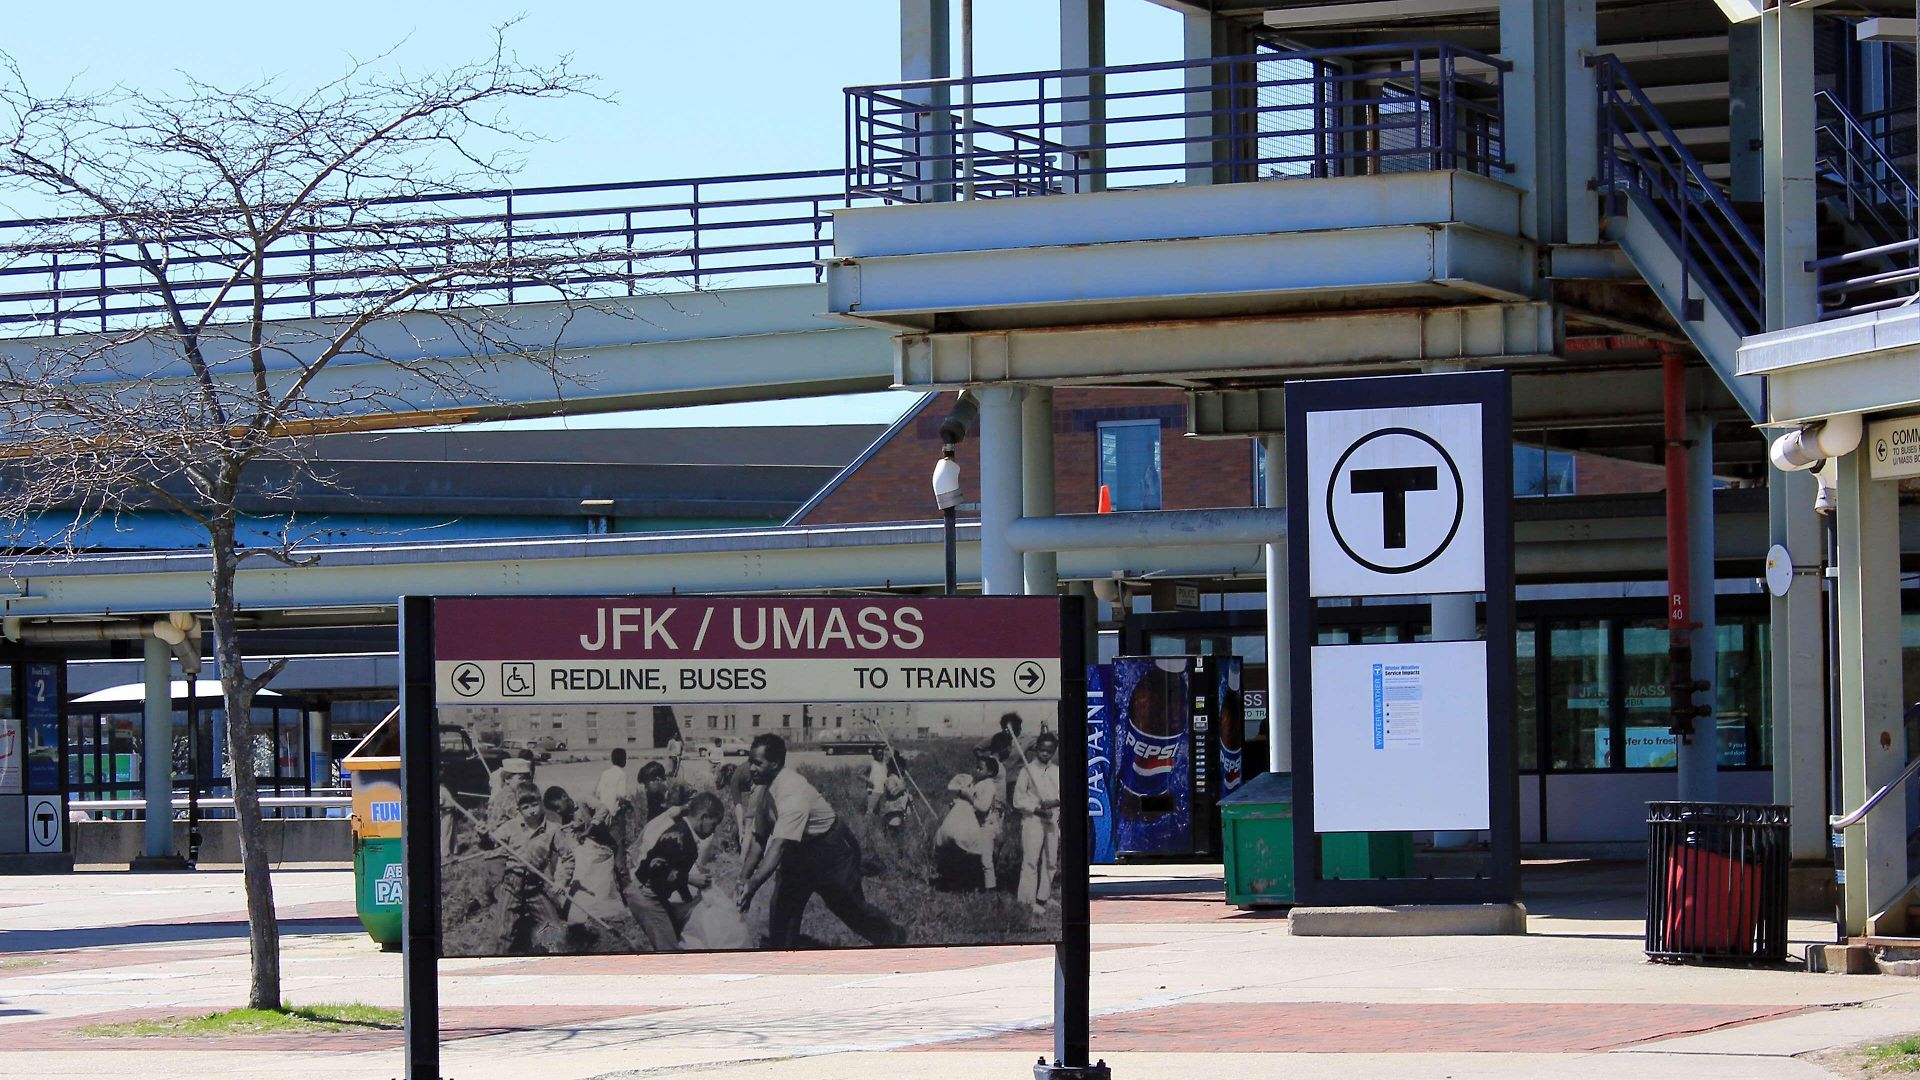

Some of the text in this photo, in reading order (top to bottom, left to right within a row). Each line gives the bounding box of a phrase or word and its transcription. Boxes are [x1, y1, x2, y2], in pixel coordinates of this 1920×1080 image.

[1893, 447, 1900, 455] TO
[1901, 445, 1917, 455] BUSES
[1350, 466, 1437, 549] T
[1673, 594, 1681, 605] R
[1672, 609, 1683, 620] 40
[580, 606, 925, 651] JFK / UMASS
[551, 668, 767, 694] REDLINE, BUSES
[853, 667, 996, 689] TO TRAINS
[1628, 685, 1666, 697] MASS
[1374, 678, 1383, 746] WINTER WEATHER
[1126, 731, 1179, 760] PEPSI
[1643, 737, 1654, 745] to
[1220, 751, 1242, 773] PEPSI
[371, 802, 401, 822] FUN
[37, 813, 54, 839] T
